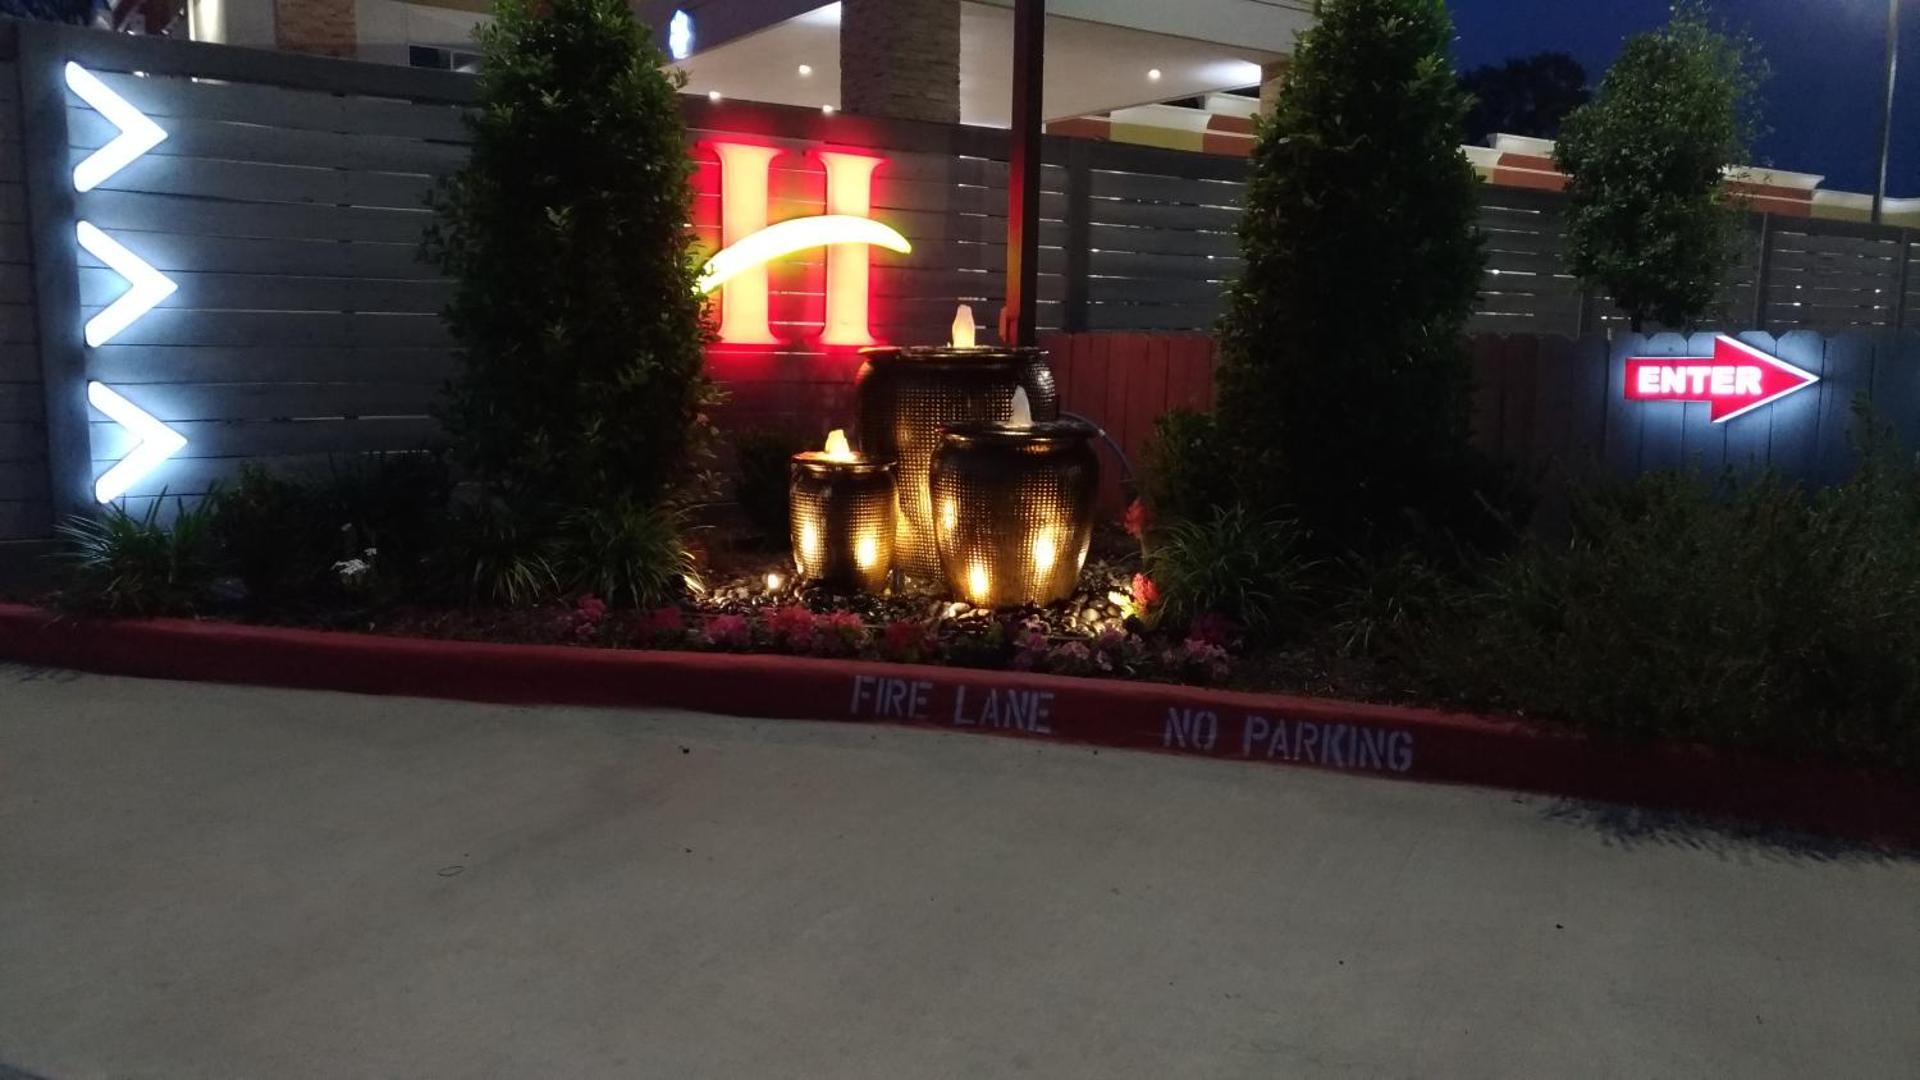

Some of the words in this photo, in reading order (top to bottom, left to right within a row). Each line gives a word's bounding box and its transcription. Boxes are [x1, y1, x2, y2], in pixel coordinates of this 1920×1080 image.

[1637, 365, 1763, 395] ENTER
[851, 674, 933, 719] FIRE
[953, 685, 1054, 735] LANE
[1163, 707, 1217, 751] NO
[1242, 716, 1414, 773] PARKING
